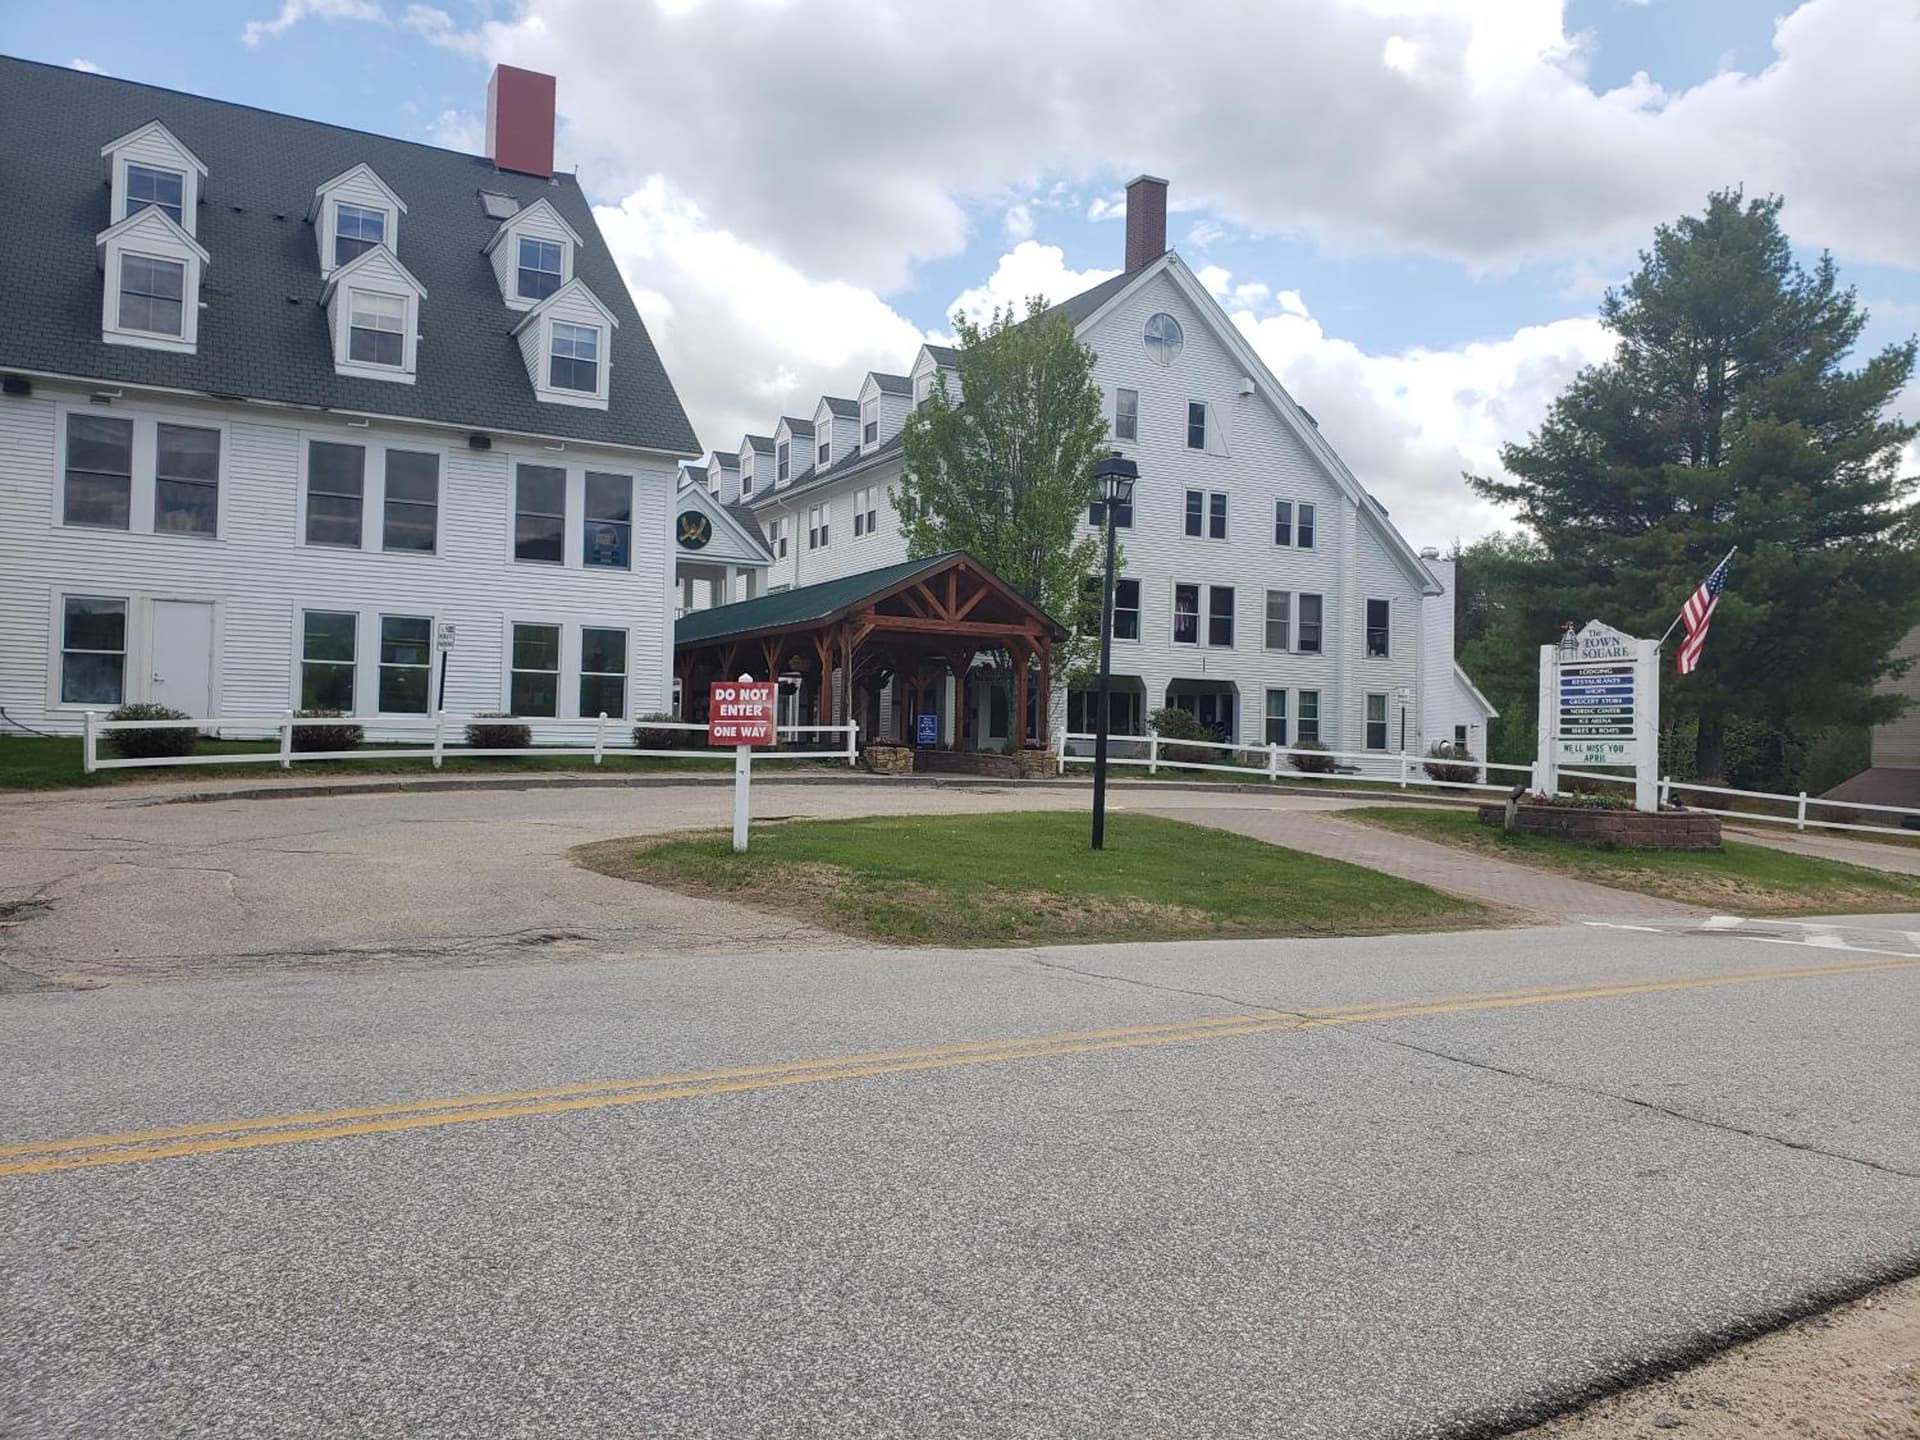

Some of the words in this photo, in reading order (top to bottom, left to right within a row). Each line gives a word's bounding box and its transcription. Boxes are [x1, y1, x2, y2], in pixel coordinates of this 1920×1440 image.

[1585, 637, 1620, 648] TOWN
[1582, 647, 1629, 659] SQUARE
[715, 688, 736, 701] DO
[740, 688, 769, 701] NOT
[720, 704, 762, 716] ENTER
[714, 726, 737, 737] ONE
[740, 726, 767, 737] WAY
[1586, 744, 1604, 752] MISS
[1608, 744, 1624, 752] YOU
[1584, 754, 1606, 762] APRIL
